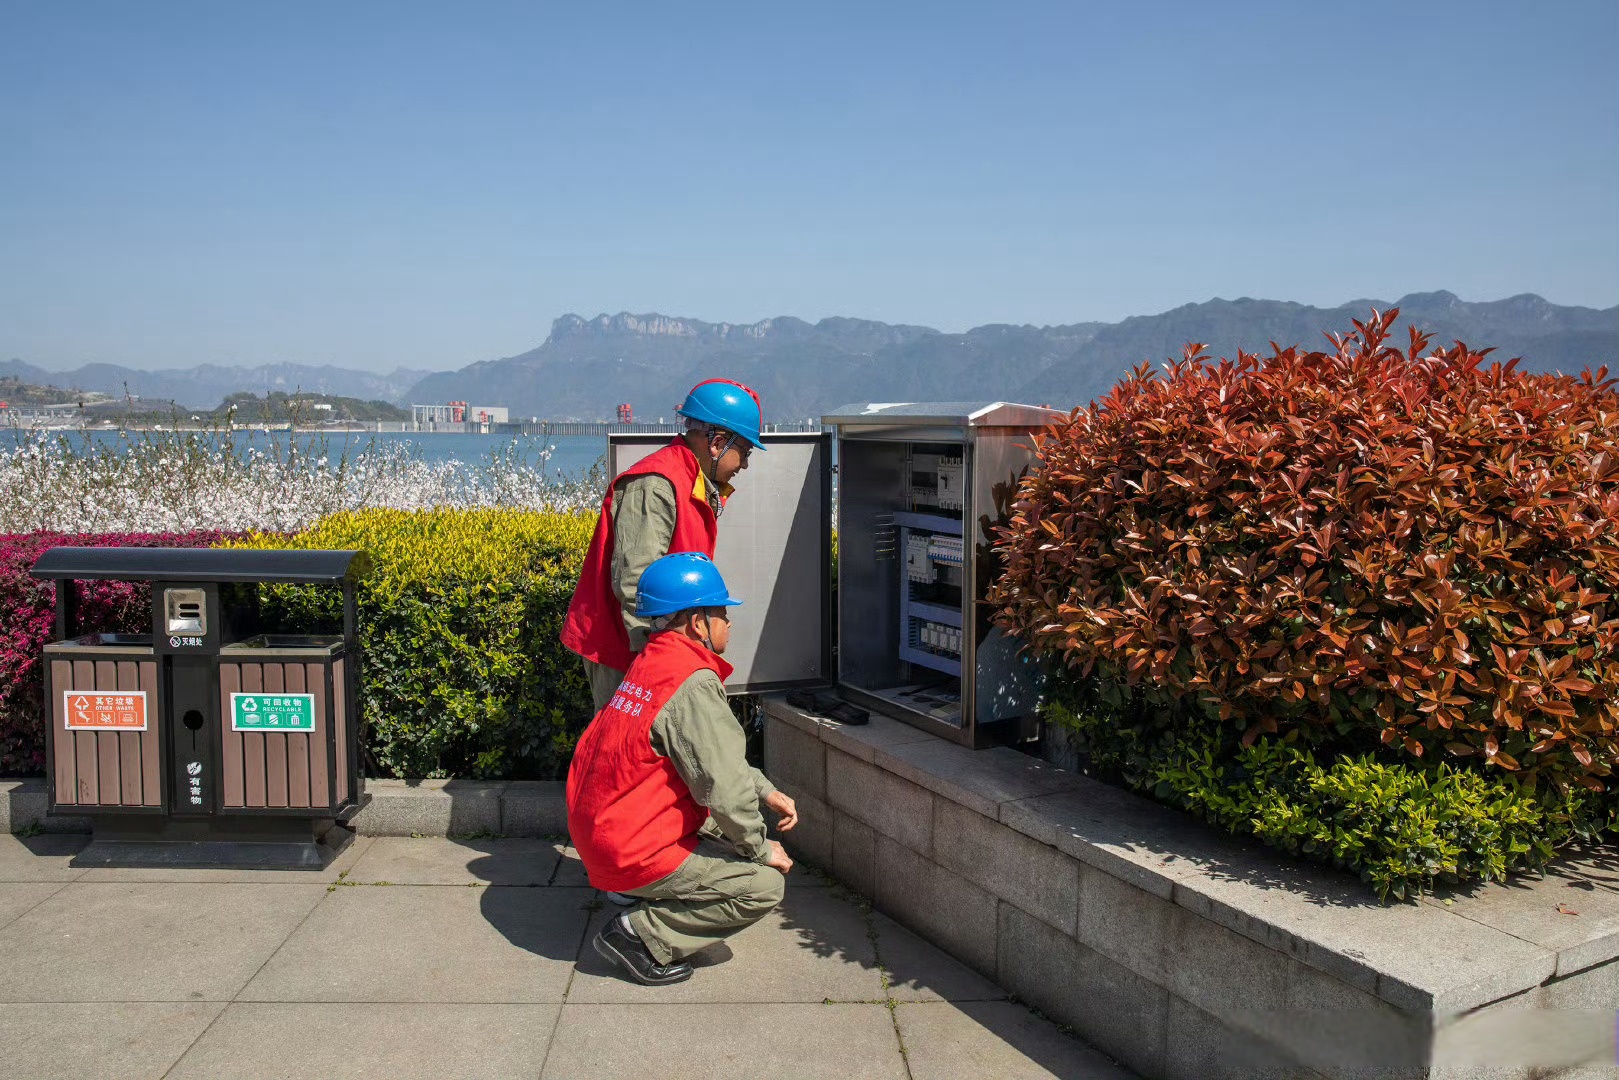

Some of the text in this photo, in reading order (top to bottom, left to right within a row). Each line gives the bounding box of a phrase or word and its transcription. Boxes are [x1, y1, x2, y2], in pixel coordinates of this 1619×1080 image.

[182, 637, 203, 646] 灭烟处
[95, 697, 134, 706] 其它垃圾
[262, 698, 302, 707] 可回收物
